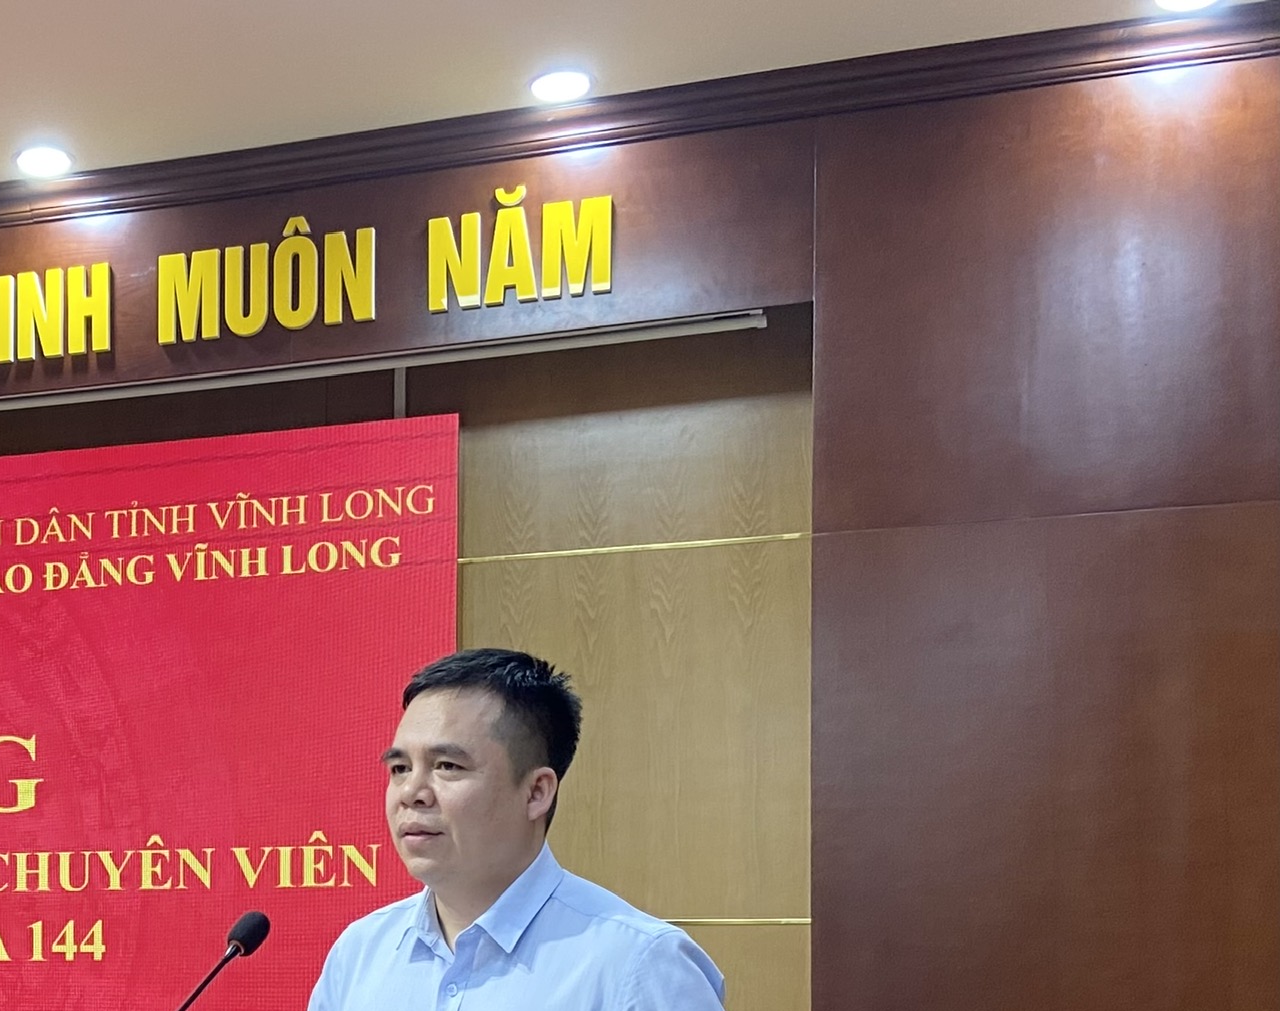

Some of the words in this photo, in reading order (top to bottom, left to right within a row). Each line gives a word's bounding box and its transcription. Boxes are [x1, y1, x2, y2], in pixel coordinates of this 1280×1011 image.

[156, 216, 376, 346] MUÔN
[427, 185, 614, 313] NĂM
[15, 506, 95, 546] DÂN
[105, 500, 198, 539] TỈNH
[207, 492, 308, 529] VĨNH
[320, 485, 434, 523] LONG
[166, 543, 269, 582] VĨNH
[281, 536, 401, 575] LONG
[231, 830, 381, 889] VIÊN
[28, 919, 106, 962] 144
